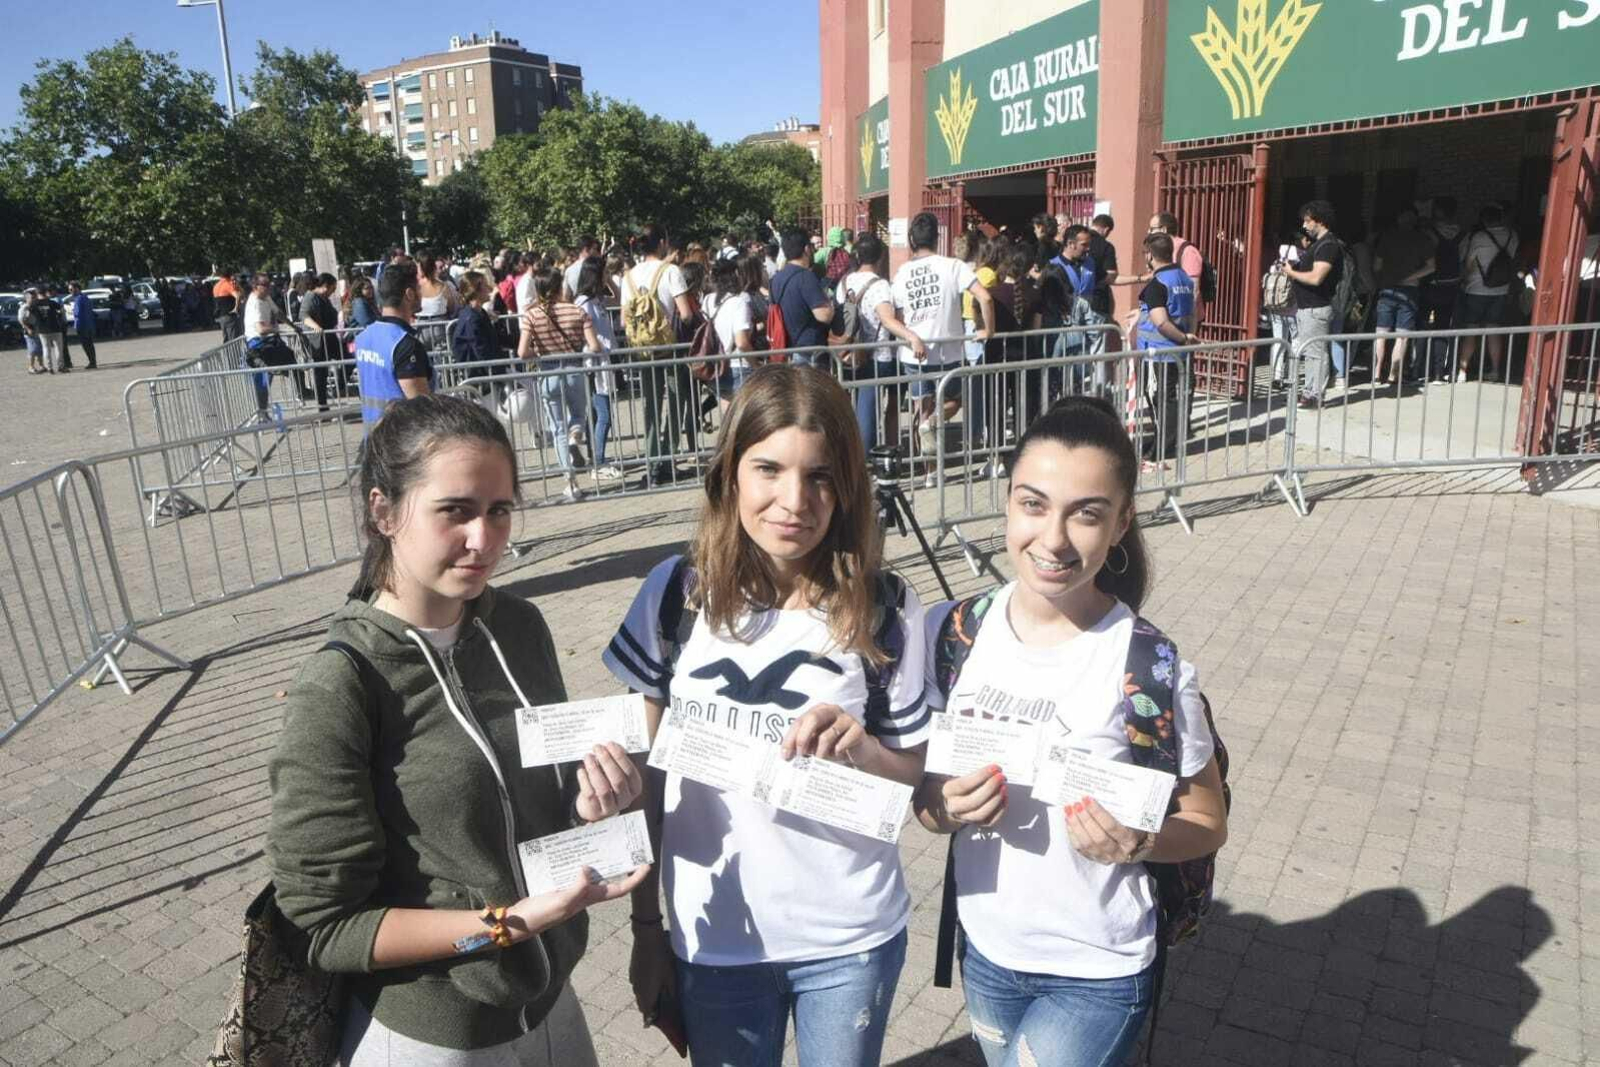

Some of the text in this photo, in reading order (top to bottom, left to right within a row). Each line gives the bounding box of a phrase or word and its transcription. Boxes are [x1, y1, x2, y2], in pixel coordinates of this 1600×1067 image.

[1397, 0, 1528, 61] DEL
[990, 35, 1099, 101] CAJA RURAL
[1001, 84, 1086, 136] DEL SUR
[905, 273, 939, 290] COLD
[908, 284, 940, 301] SOLD
